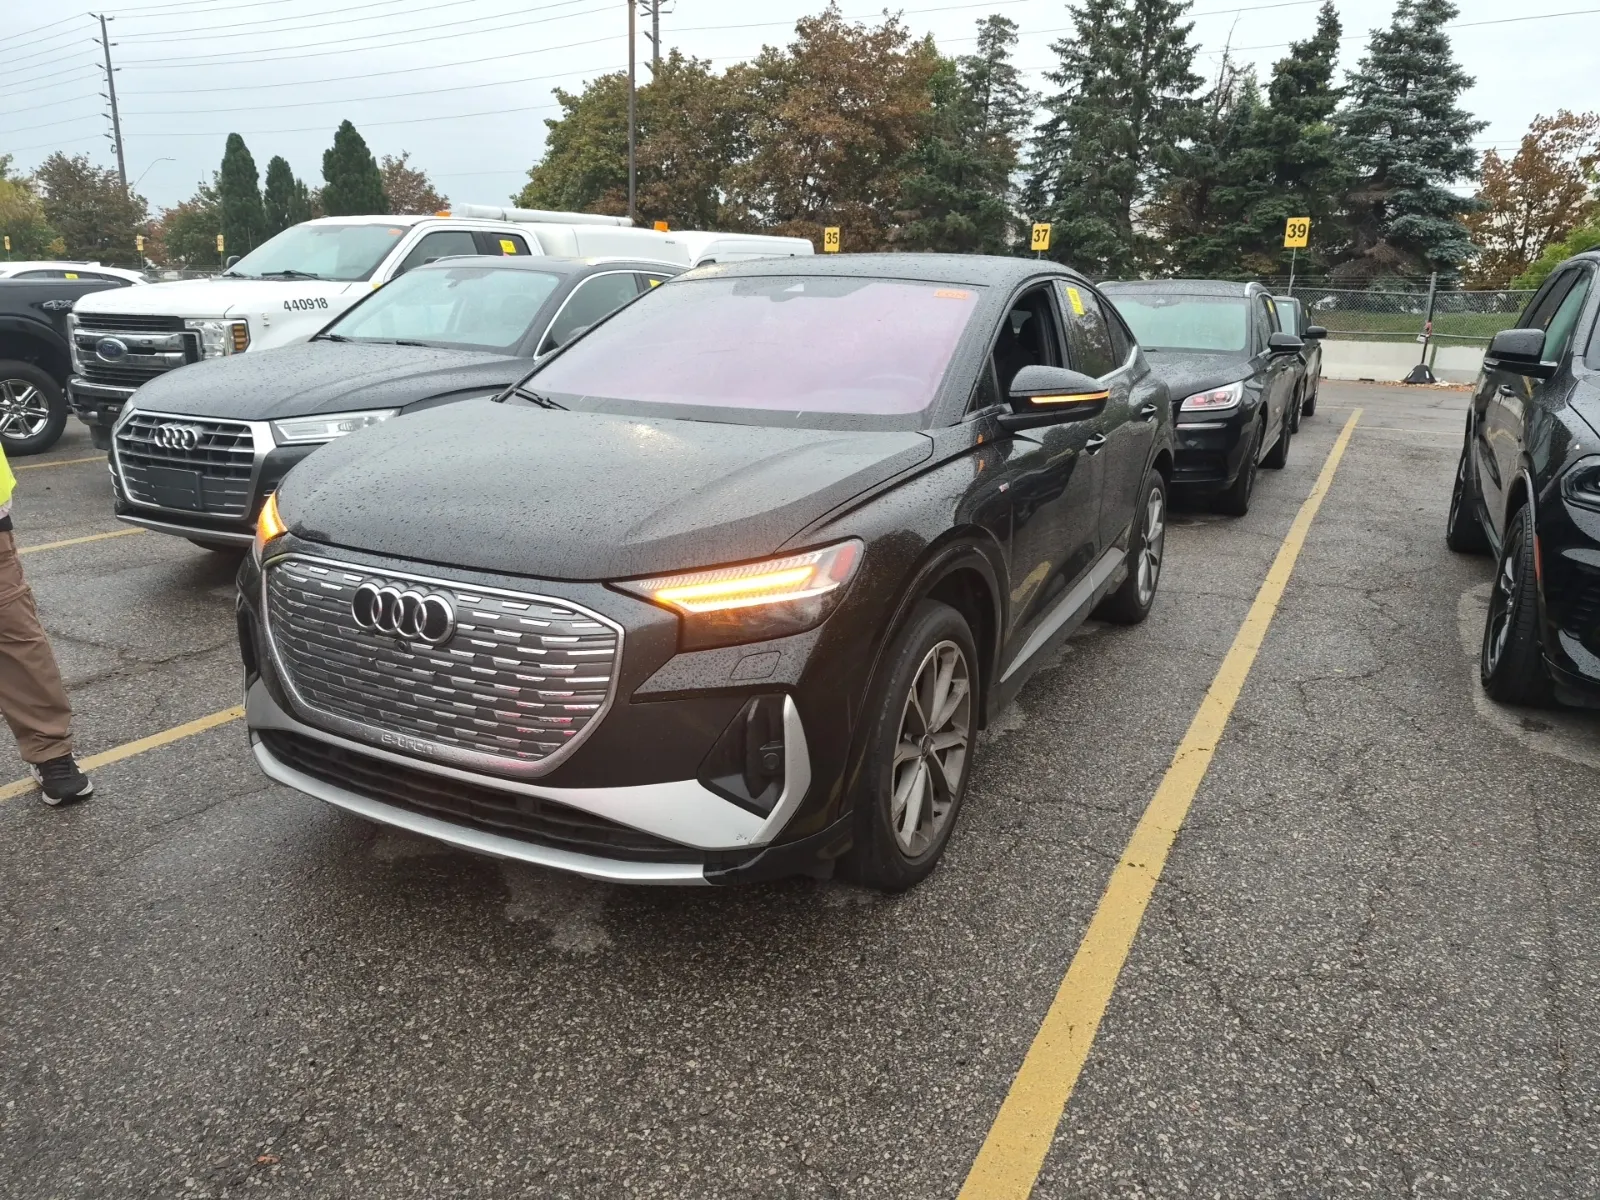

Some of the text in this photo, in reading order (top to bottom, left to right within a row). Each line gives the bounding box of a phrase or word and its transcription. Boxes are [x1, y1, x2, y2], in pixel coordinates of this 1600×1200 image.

[1033, 229, 1048, 243] 37
[1287, 223, 1307, 238] 39
[826, 232, 838, 244] 35
[283, 297, 329, 311] 440918
